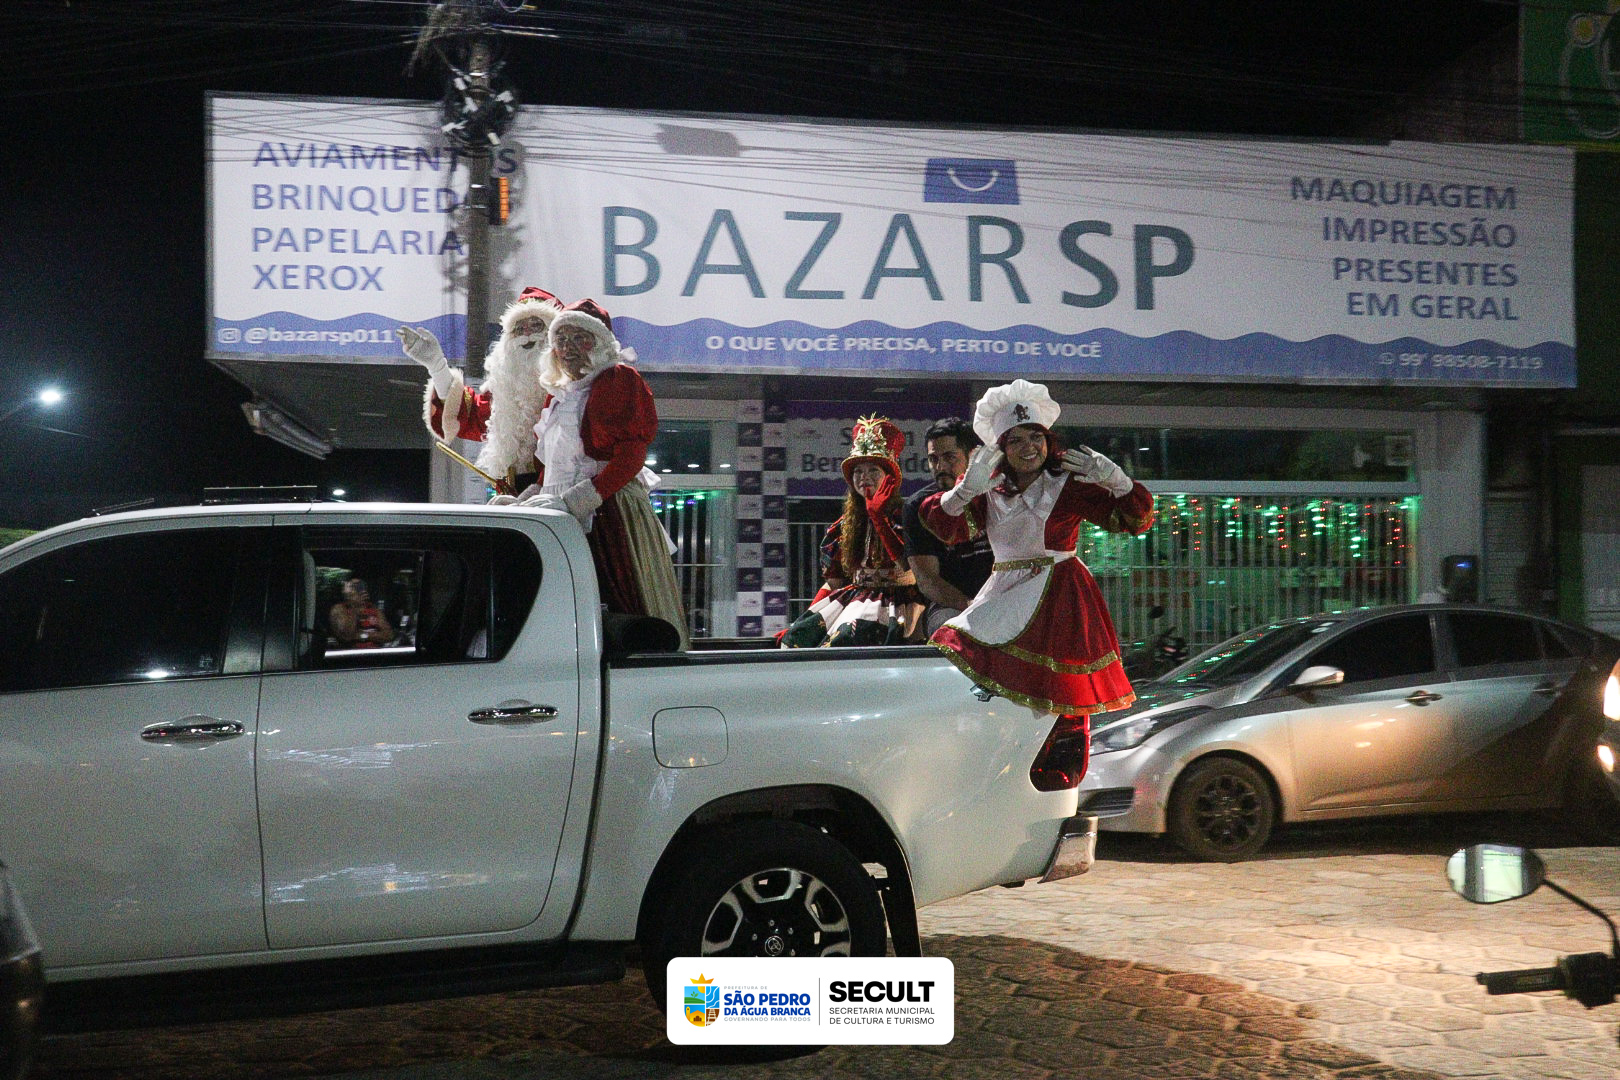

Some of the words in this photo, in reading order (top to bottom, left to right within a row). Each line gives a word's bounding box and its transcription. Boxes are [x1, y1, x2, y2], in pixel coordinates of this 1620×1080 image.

[253, 142, 517, 174] AVIAMENTS
[1291, 176, 1517, 209] MAQUIAGEM
[252, 227, 464, 256] PAPELARIA
[1323, 216, 1517, 249] IMPRESSÃO
[252, 264, 384, 291] XEROX
[1333, 257, 1519, 287] PRESENTES
[1347, 292, 1399, 317] EM
[1411, 294, 1518, 321] GERAL
[705, 335, 725, 350] O
[728, 336, 777, 352] QUE
[780, 334, 840, 352] VOCÊ
[844, 337, 937, 353] PRECISA,
[941, 338, 1009, 354] PERTO
[1014, 341, 1042, 356] DE
[1046, 341, 1101, 358] VOCÊ
